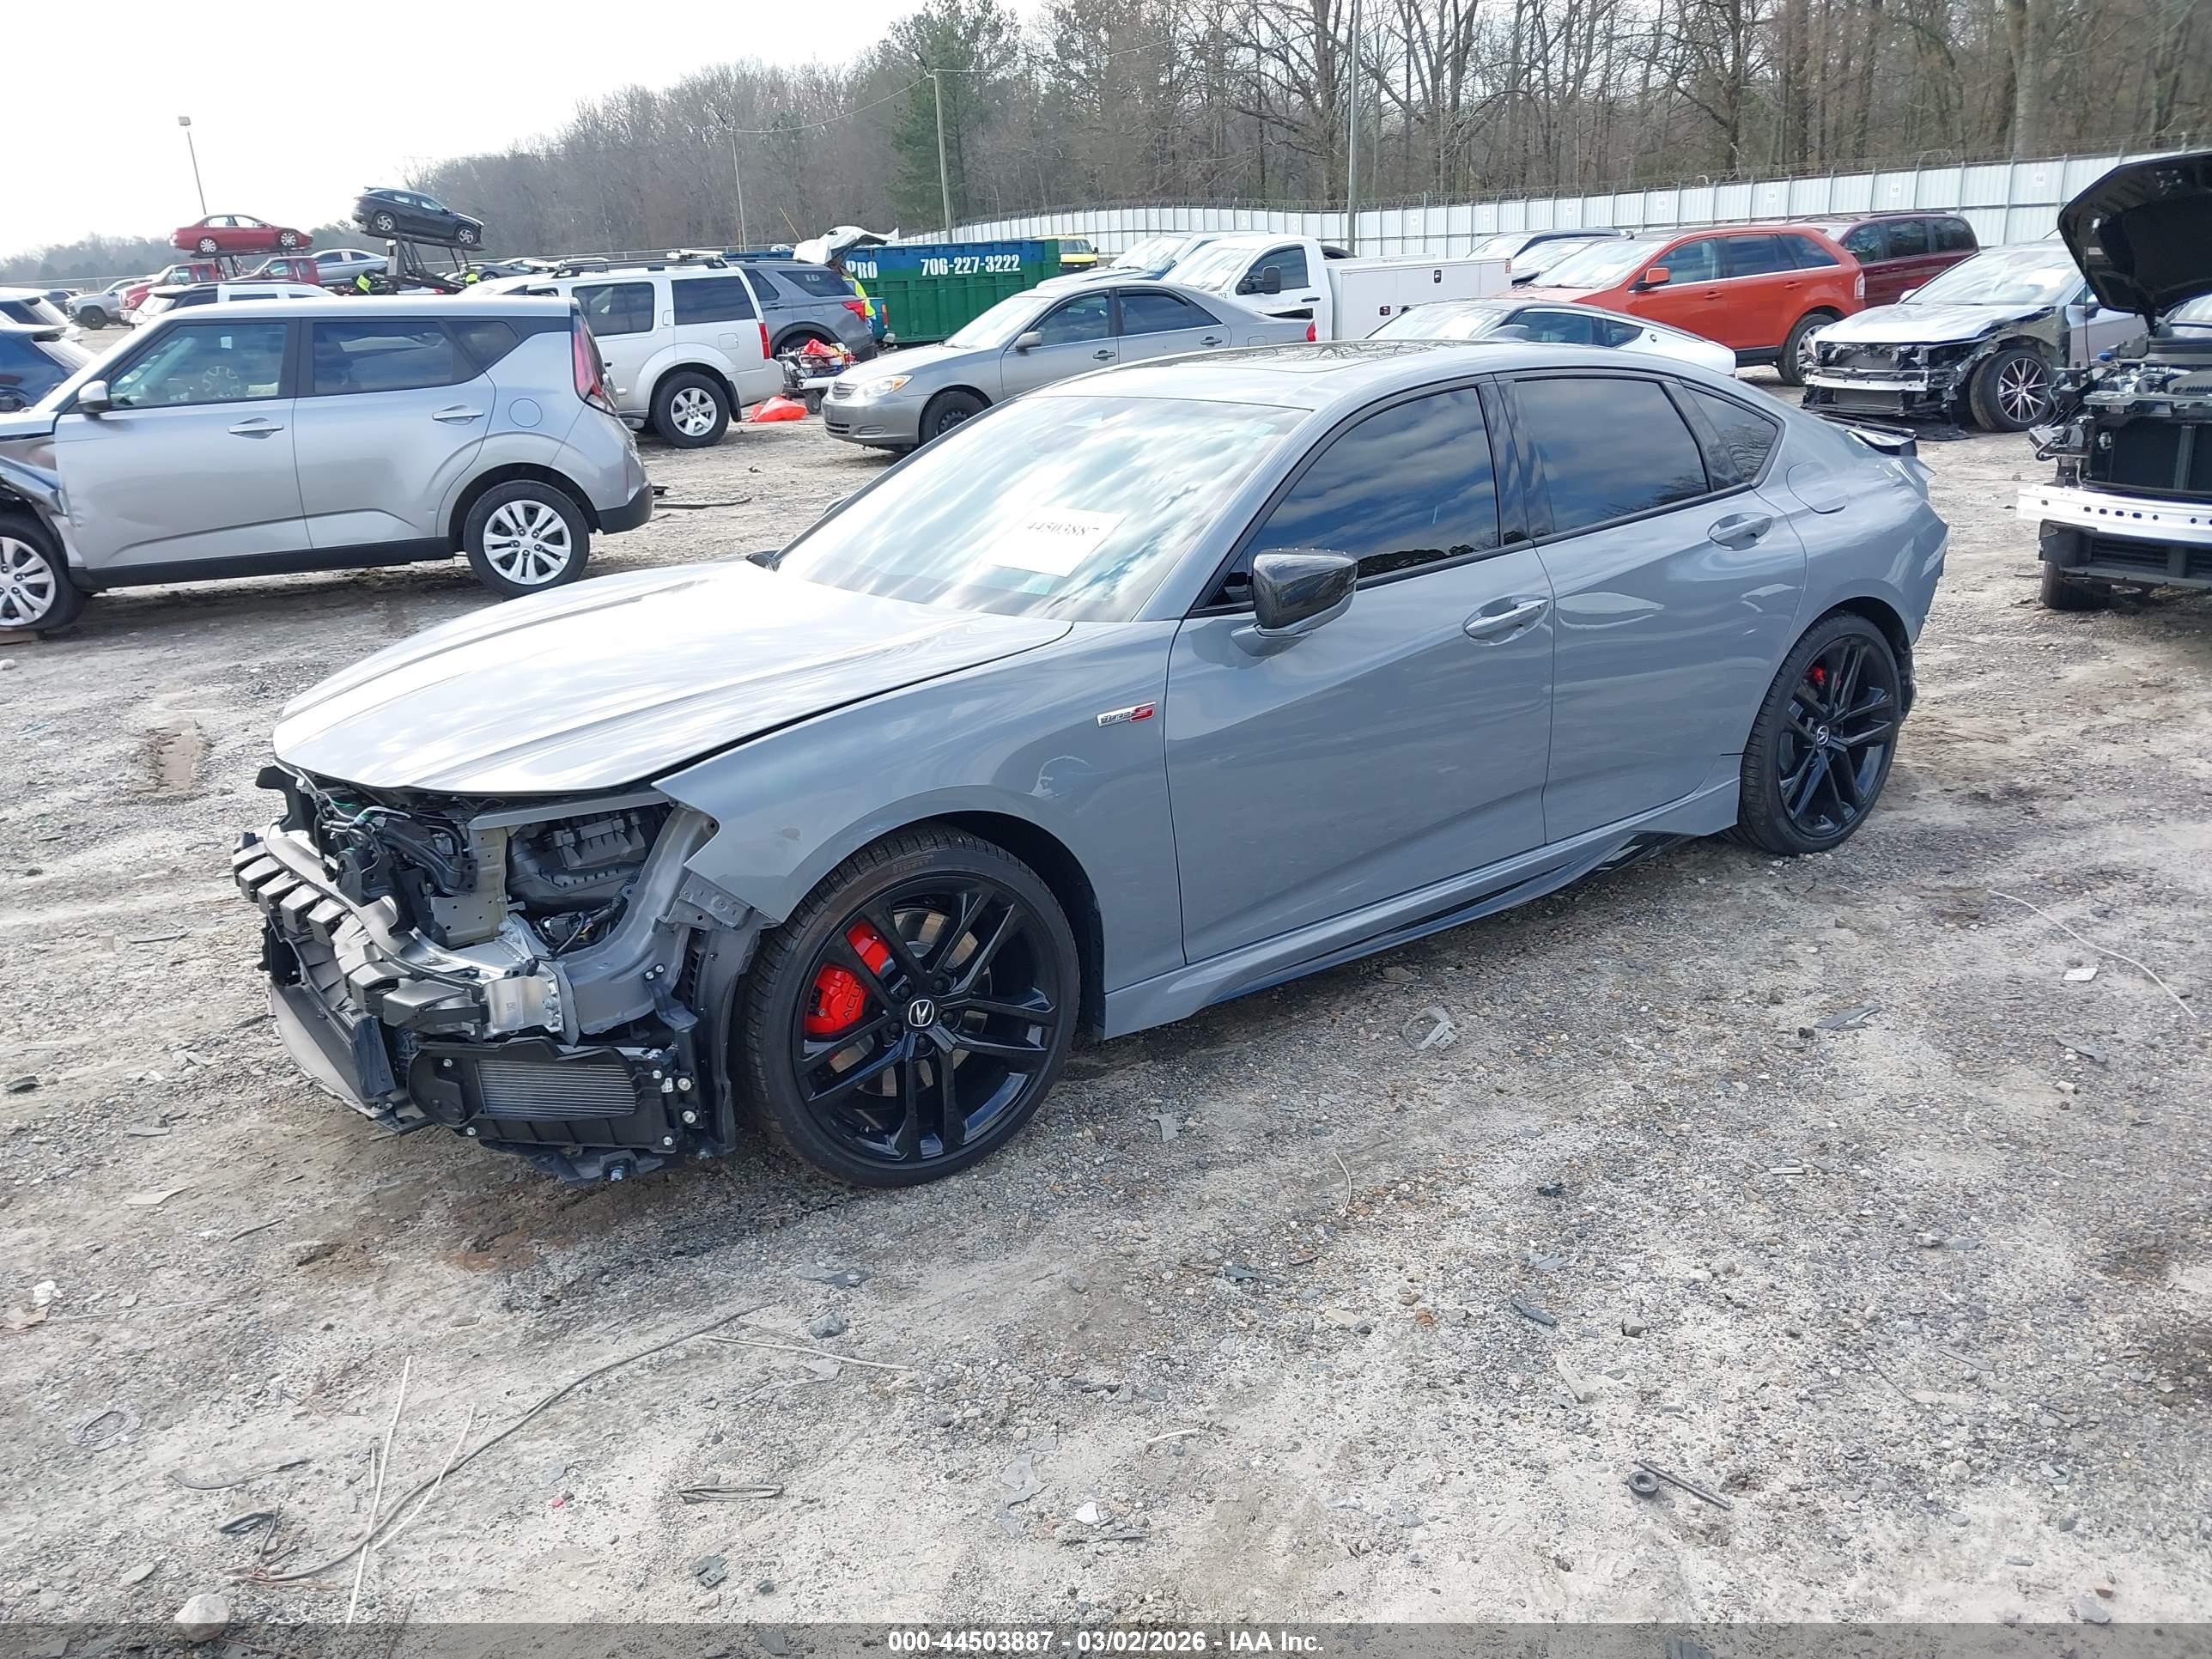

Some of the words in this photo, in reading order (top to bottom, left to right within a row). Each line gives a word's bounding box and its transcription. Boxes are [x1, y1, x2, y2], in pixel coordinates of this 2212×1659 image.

[846, 259, 878, 279] PRO
[921, 254, 1020, 276] 706-227-3222
[843, 982, 862, 1022] ACU
